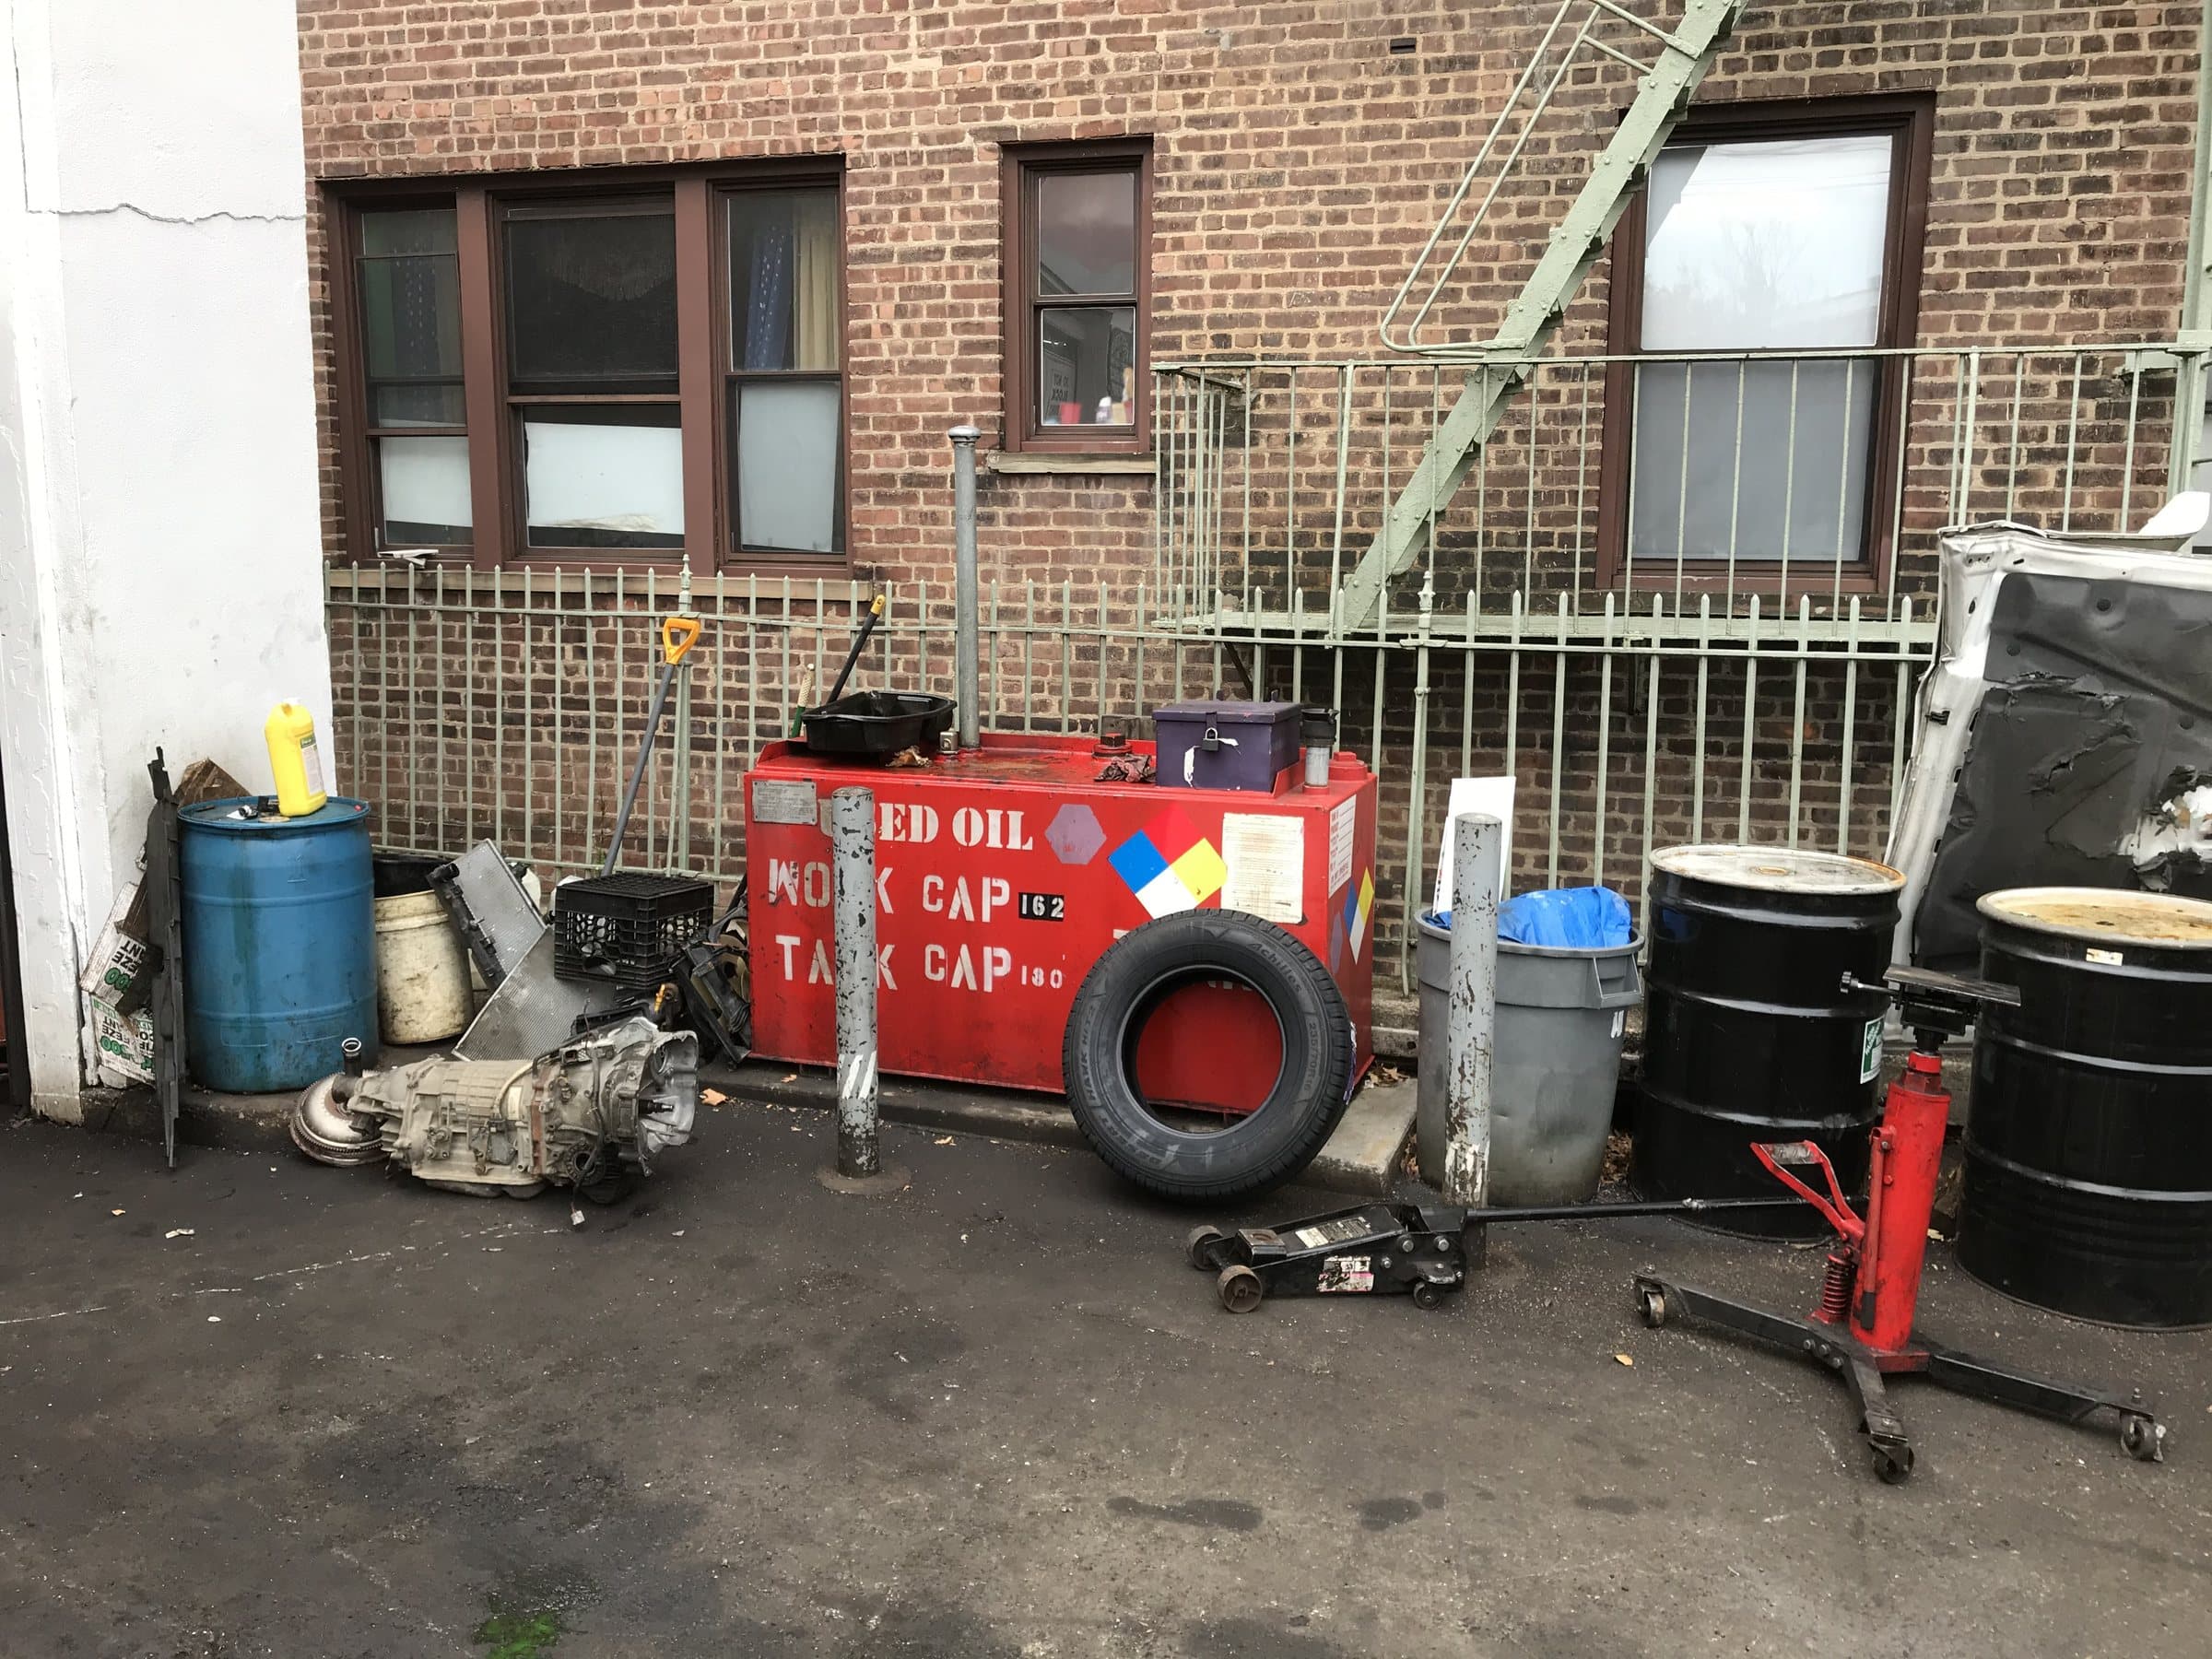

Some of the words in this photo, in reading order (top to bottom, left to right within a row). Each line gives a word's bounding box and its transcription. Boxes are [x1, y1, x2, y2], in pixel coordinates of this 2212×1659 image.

[952, 806, 1033, 850] OIL
[769, 858, 894, 914] WOK
[923, 875, 1010, 923] CAP
[1021, 894, 1065, 919] 162
[775, 935, 899, 991] TAK
[924, 944, 1012, 993] CAP
[1249, 942, 1303, 994] Achilles
[1077, 1050, 1098, 1102] HAWK
